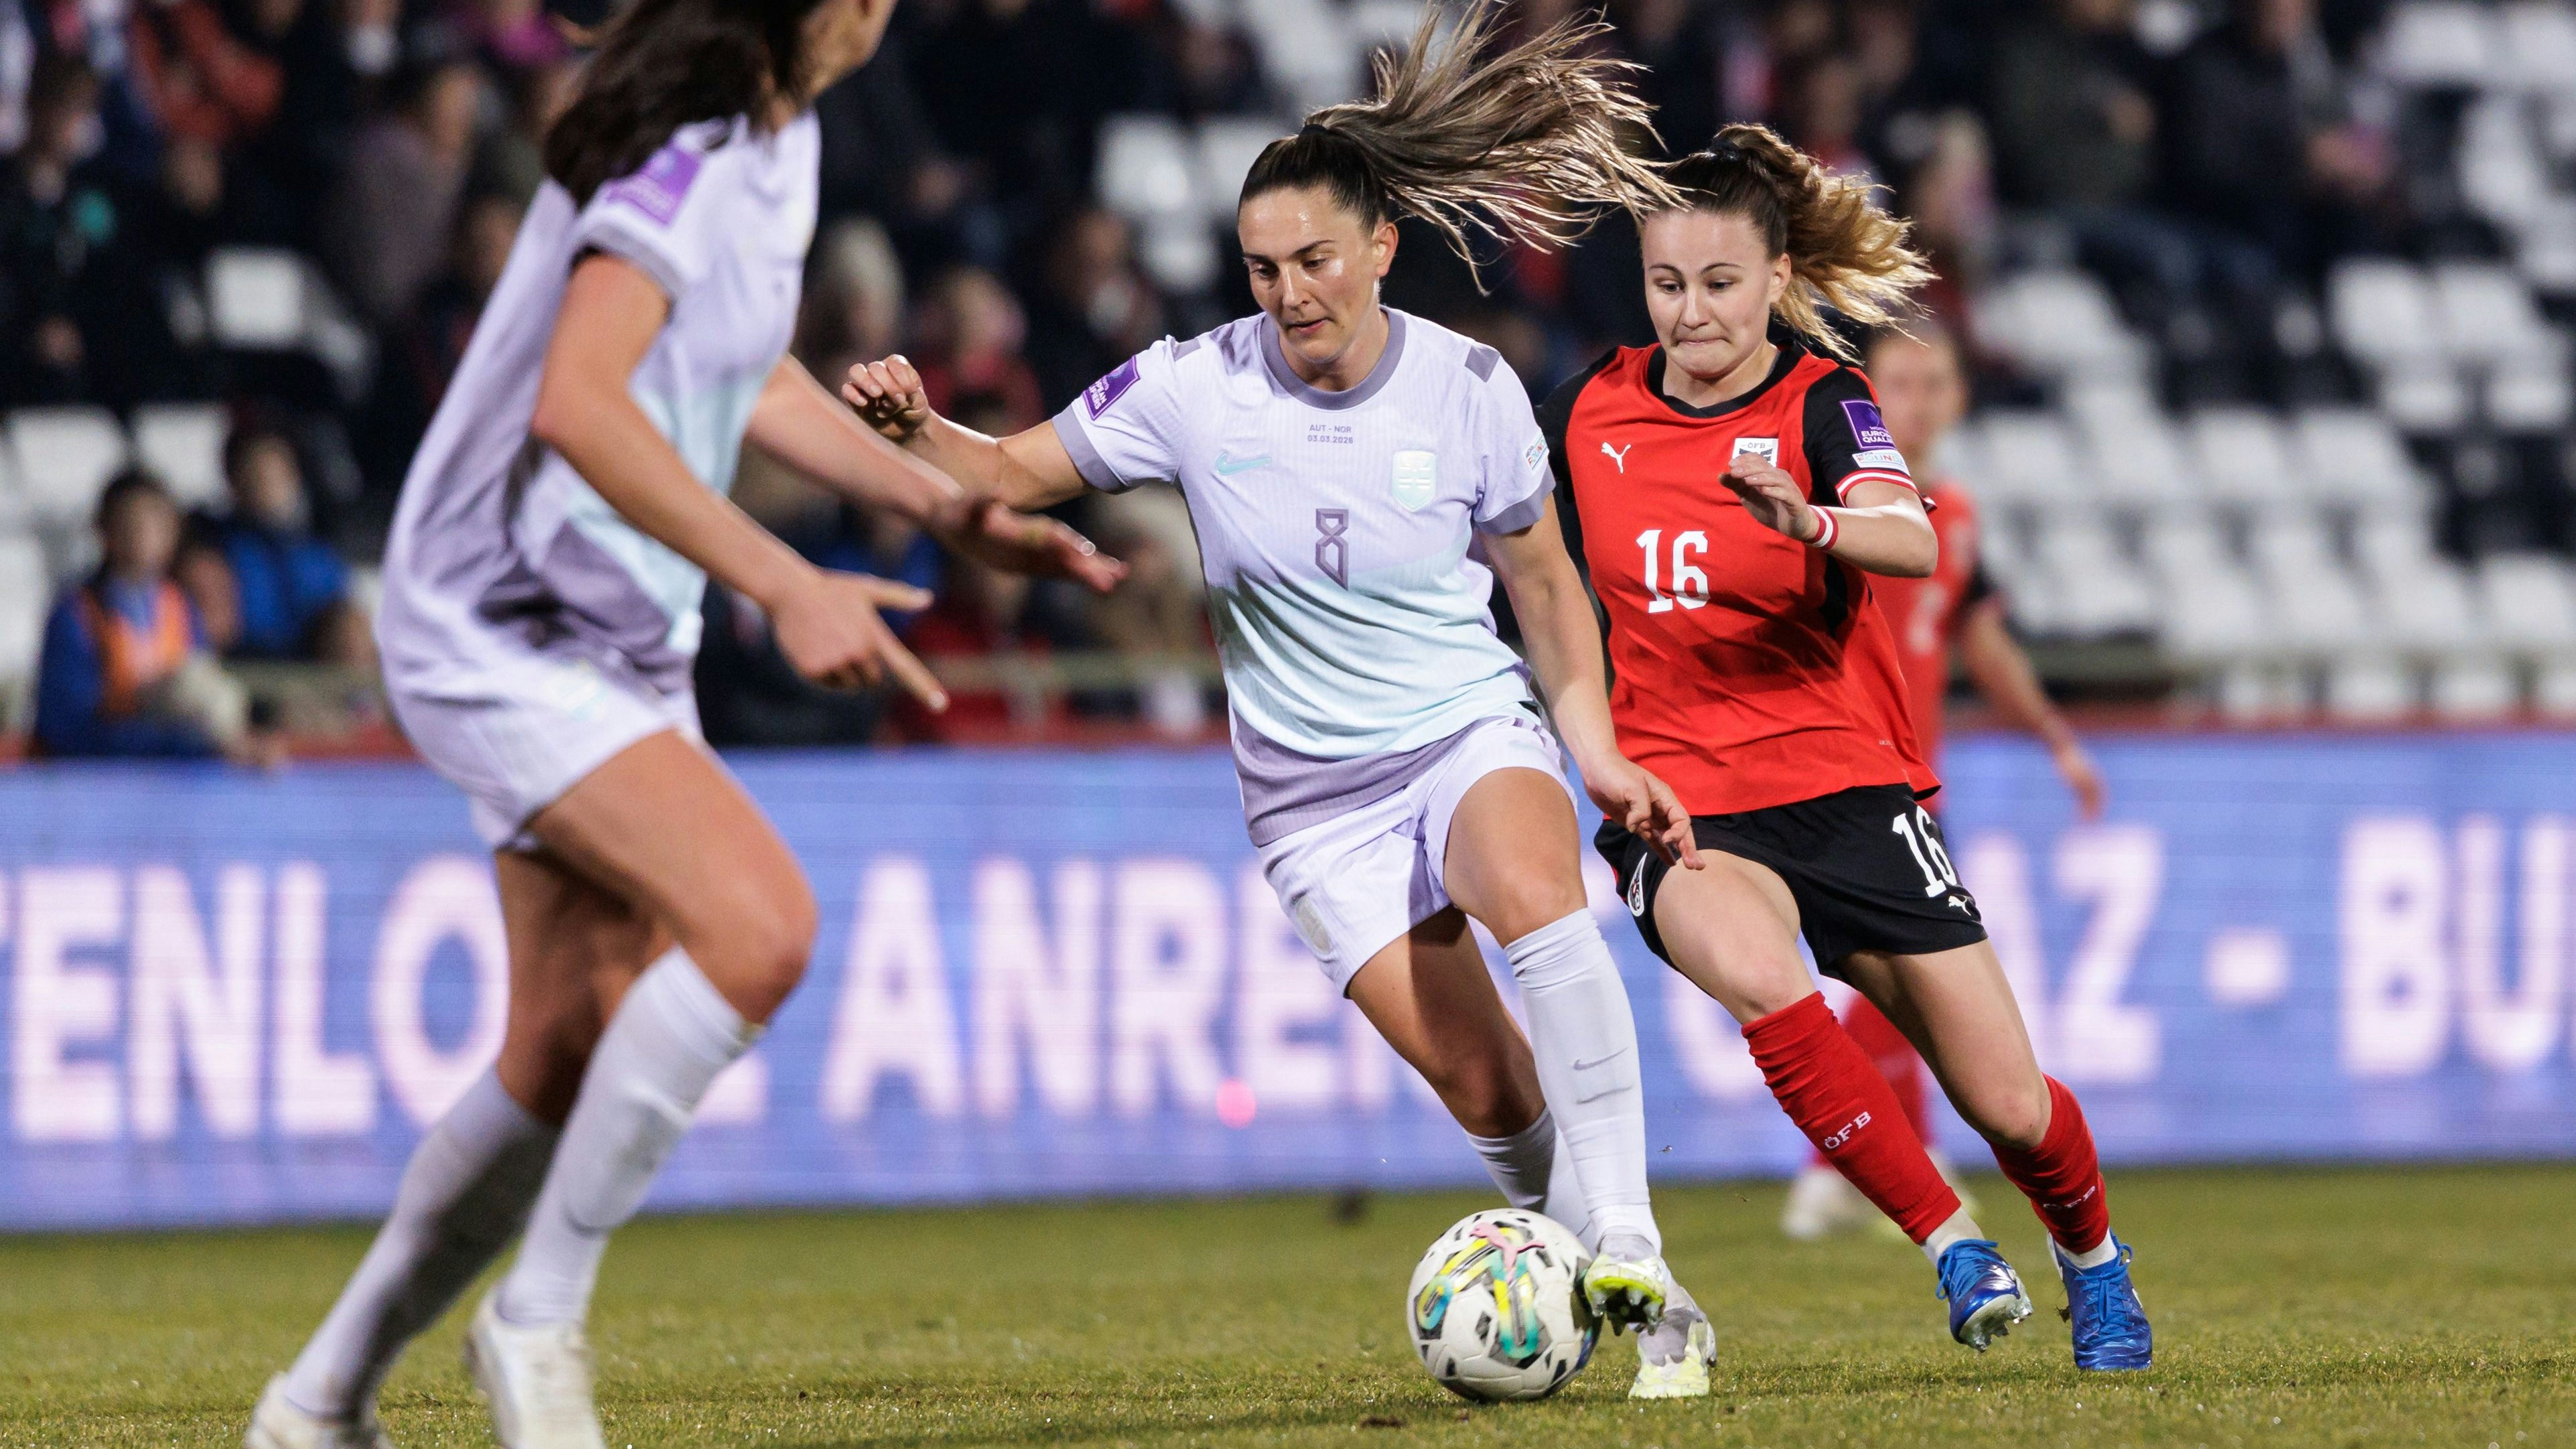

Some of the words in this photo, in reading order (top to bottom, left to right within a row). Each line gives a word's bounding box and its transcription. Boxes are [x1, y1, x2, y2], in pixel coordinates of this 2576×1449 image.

[1307, 435, 1354, 443] 03.03.2026
[1857, 455, 1904, 463] FOUND
[1315, 508, 1349, 591] 8
[1636, 529, 1709, 614] 16
[1892, 805, 1957, 898] 16
[0, 852, 769, 1139] ENLO
[820, 856, 1621, 1129] ANRE
[2341, 813, 2576, 1079] BU
[1824, 1111, 1871, 1149] ÖFB
